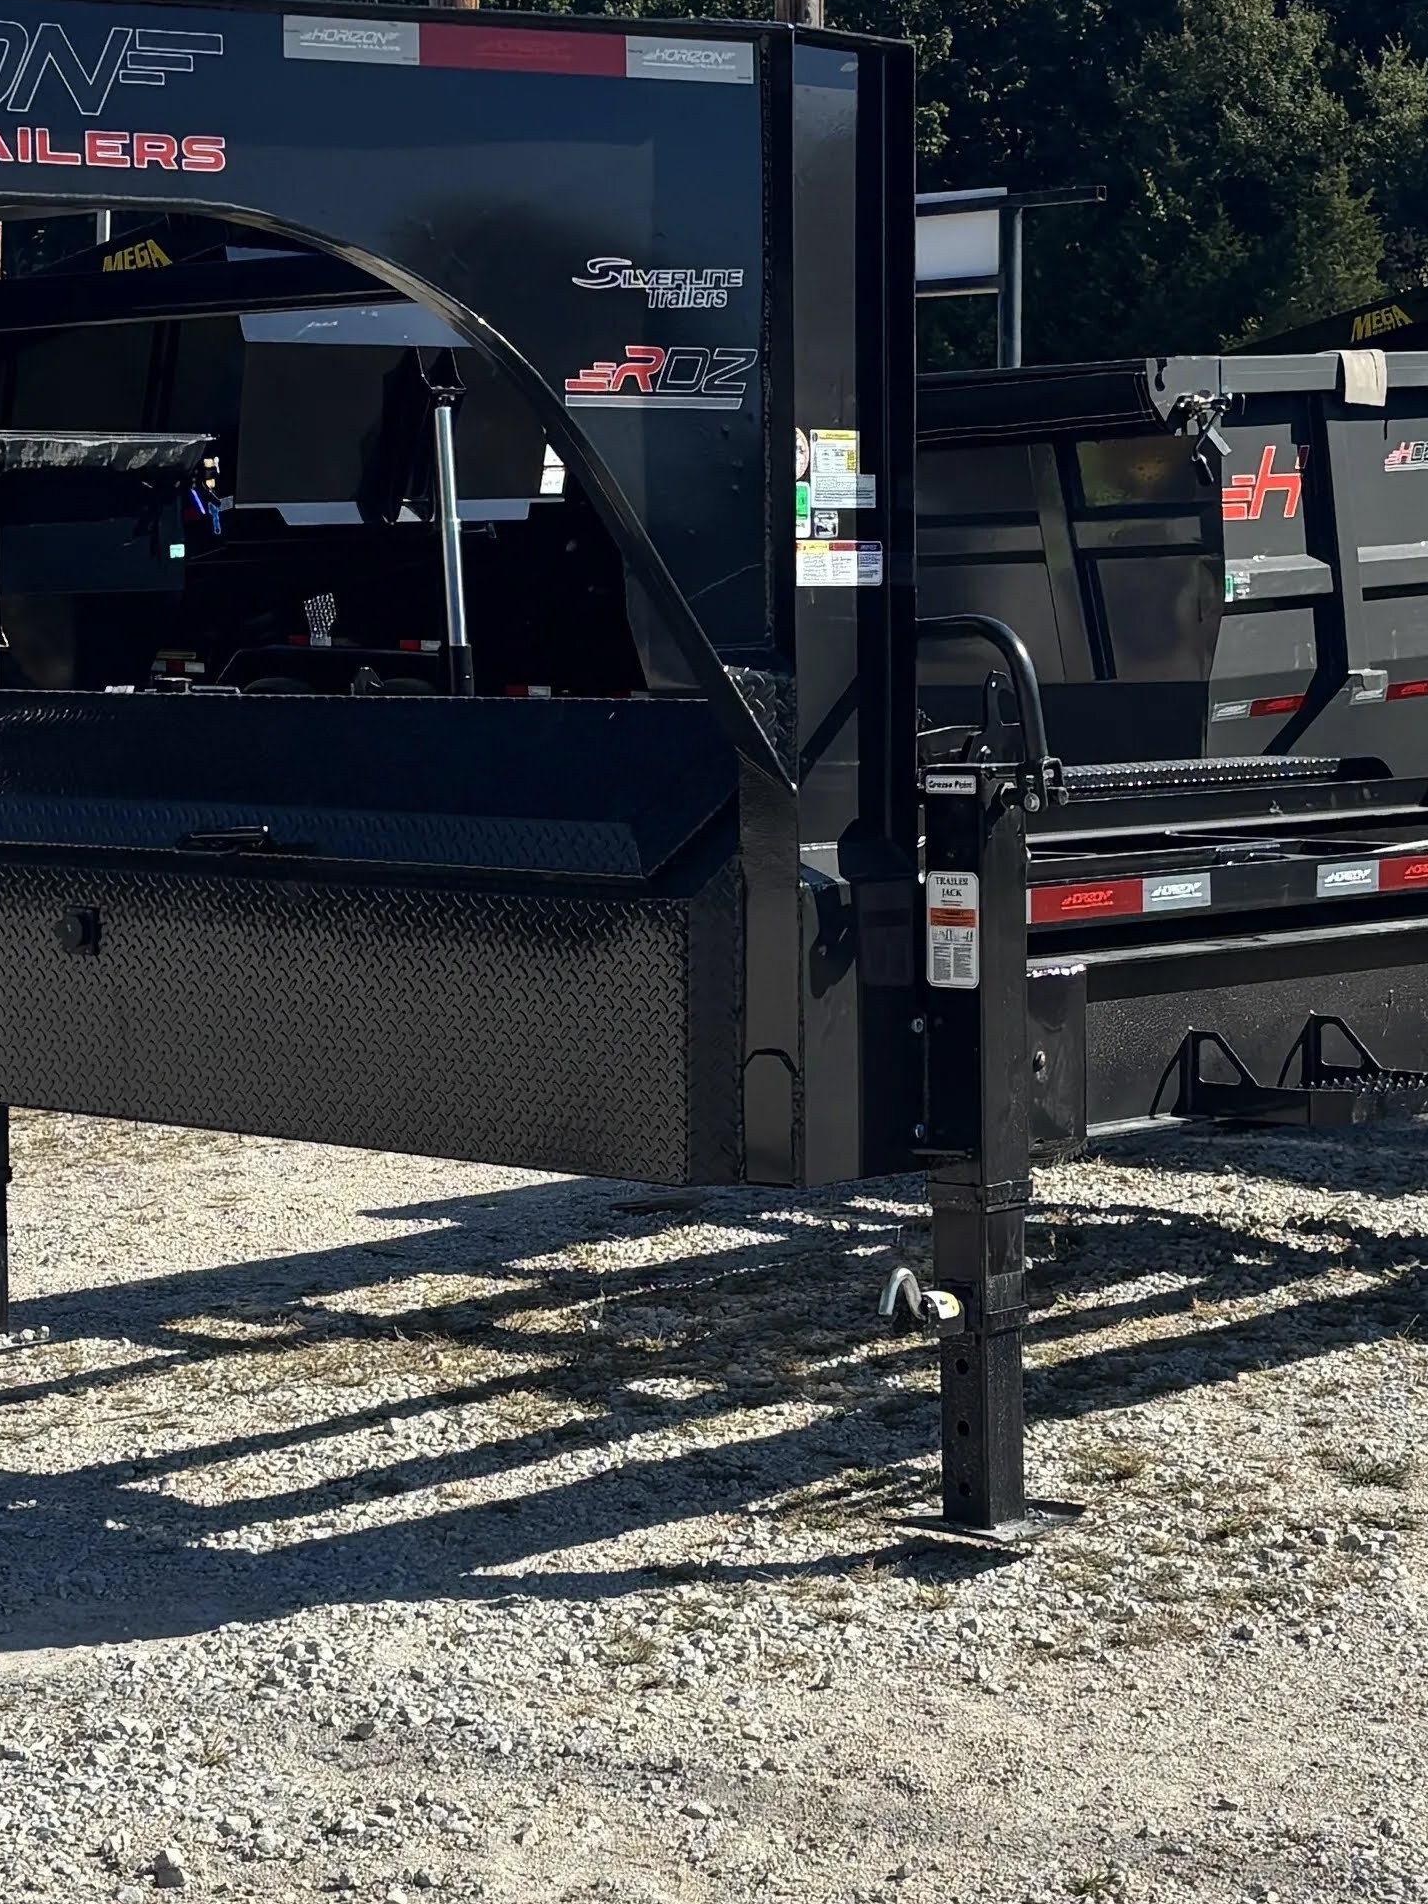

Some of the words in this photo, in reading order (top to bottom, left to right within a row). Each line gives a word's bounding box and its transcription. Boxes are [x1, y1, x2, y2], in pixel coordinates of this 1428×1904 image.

[102, 239, 173, 272] MEGA
[646, 288, 728, 309] Trailers
[1351, 304, 1414, 343] MEGA
[610, 345, 759, 394] RDZ
[935, 876, 969, 886] TRAILER
[941, 887, 963, 898] JACK
